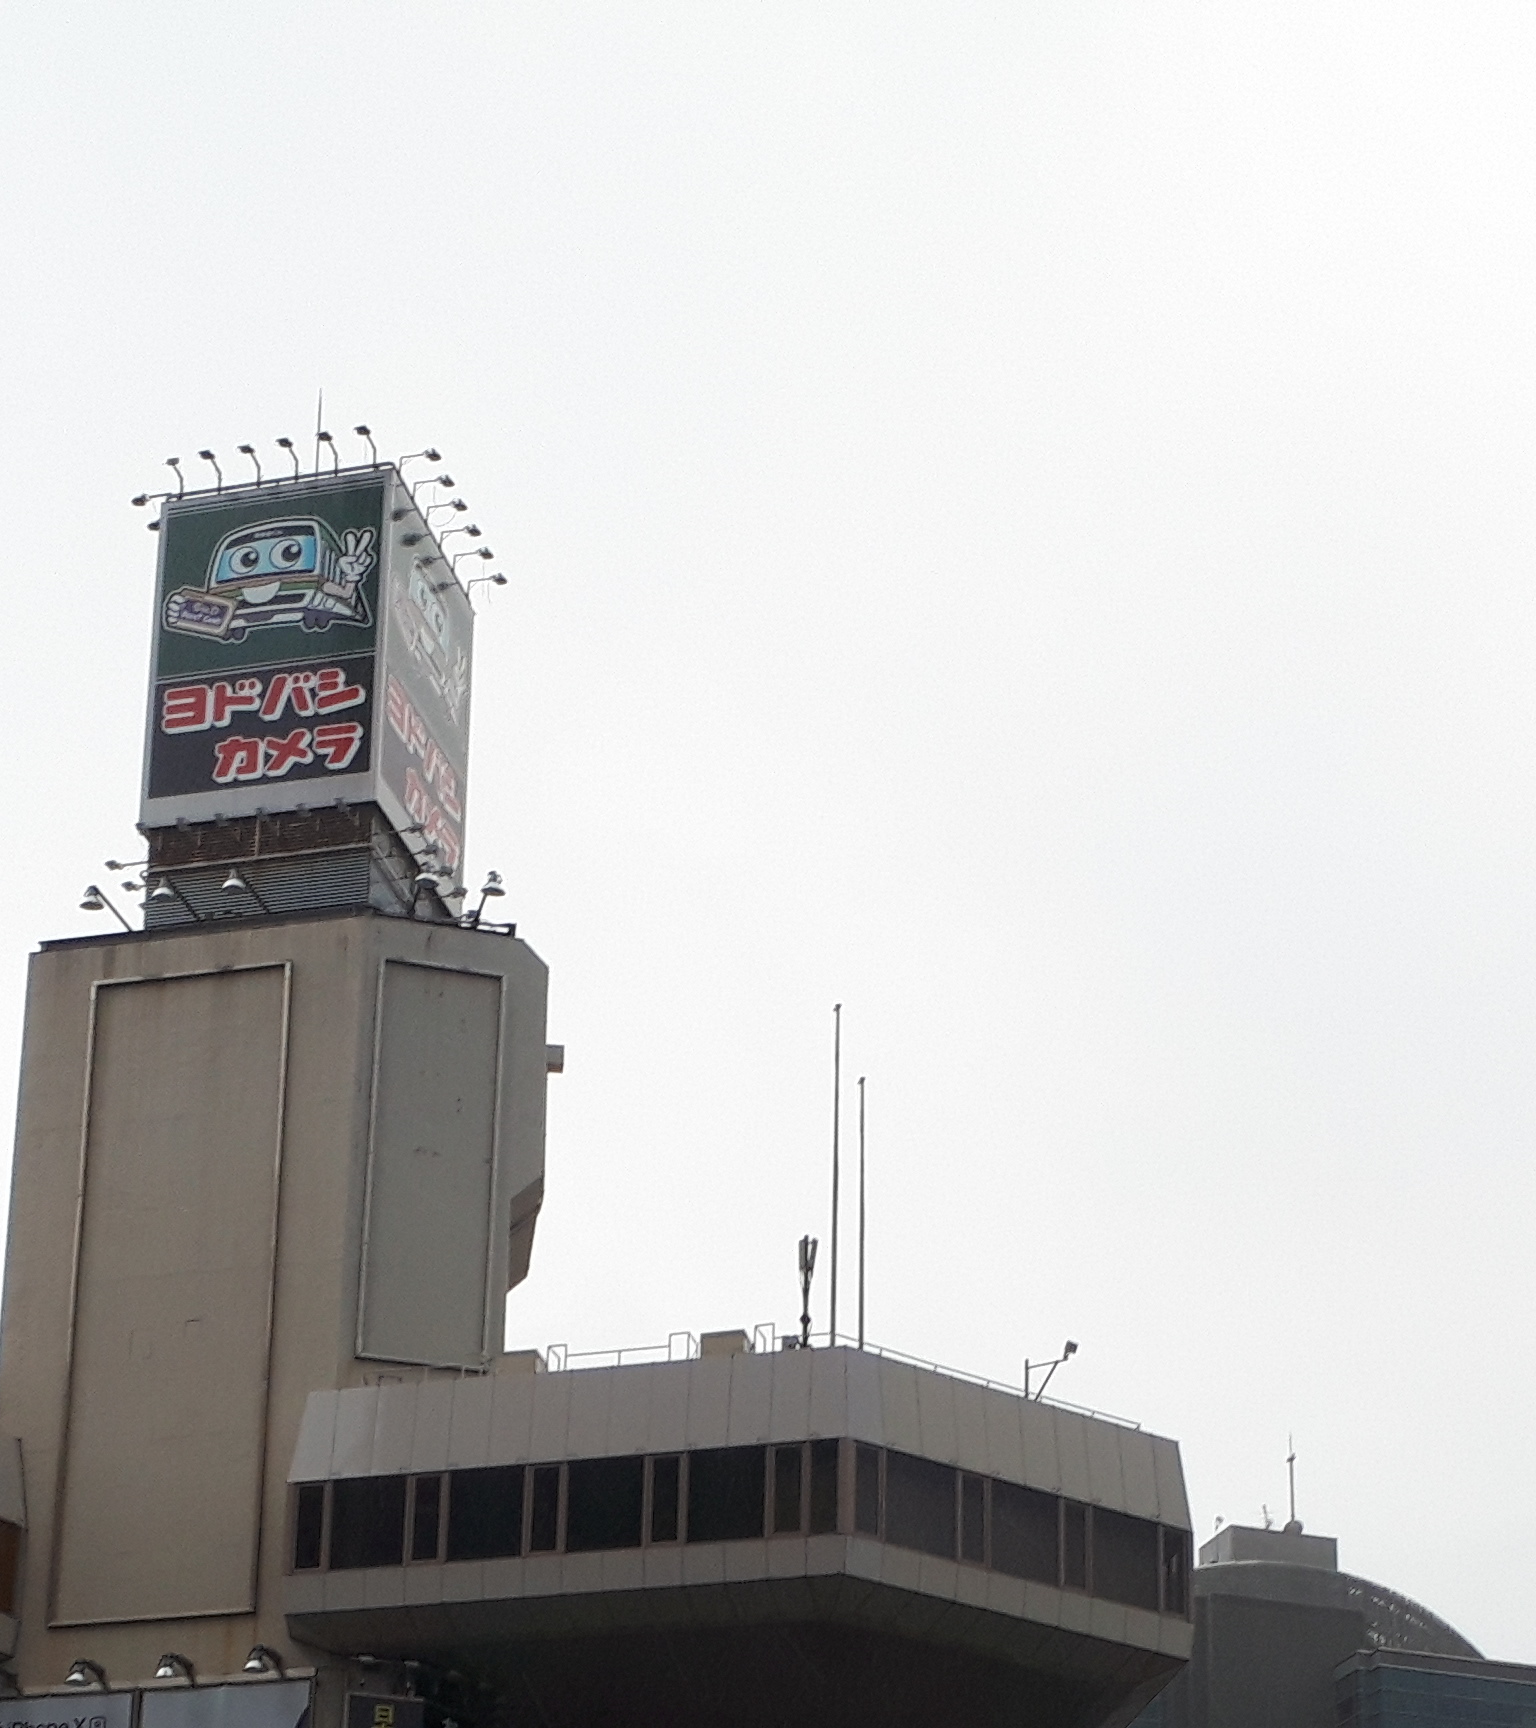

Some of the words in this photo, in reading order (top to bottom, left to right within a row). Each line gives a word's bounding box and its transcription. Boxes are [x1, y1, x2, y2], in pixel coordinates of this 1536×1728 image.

[163, 668, 365, 733] ヨドバシ
[212, 723, 363, 783] カメラ
